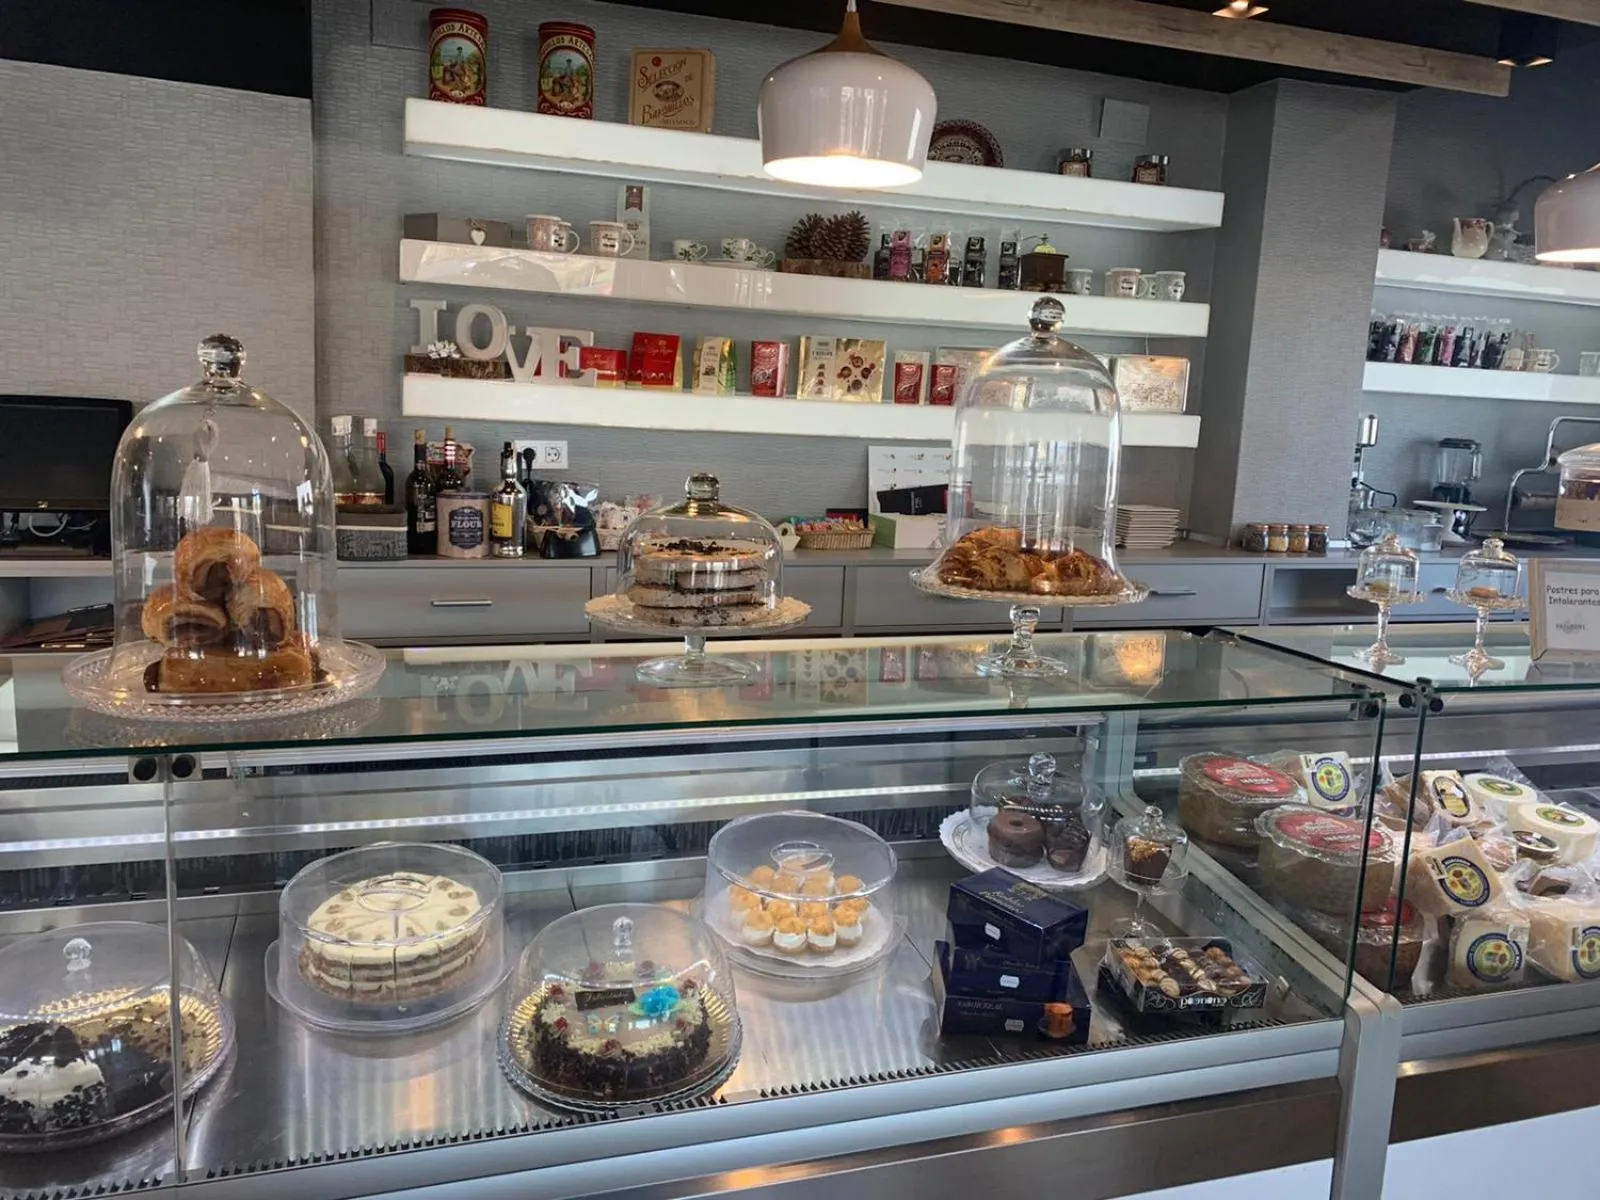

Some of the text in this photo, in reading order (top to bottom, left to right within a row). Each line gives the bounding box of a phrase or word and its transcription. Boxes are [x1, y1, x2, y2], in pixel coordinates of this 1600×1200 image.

[410, 299, 598, 388] LOVE
[451, 520, 483, 529] FLOUR
[1546, 585, 1600, 597] Postres para
